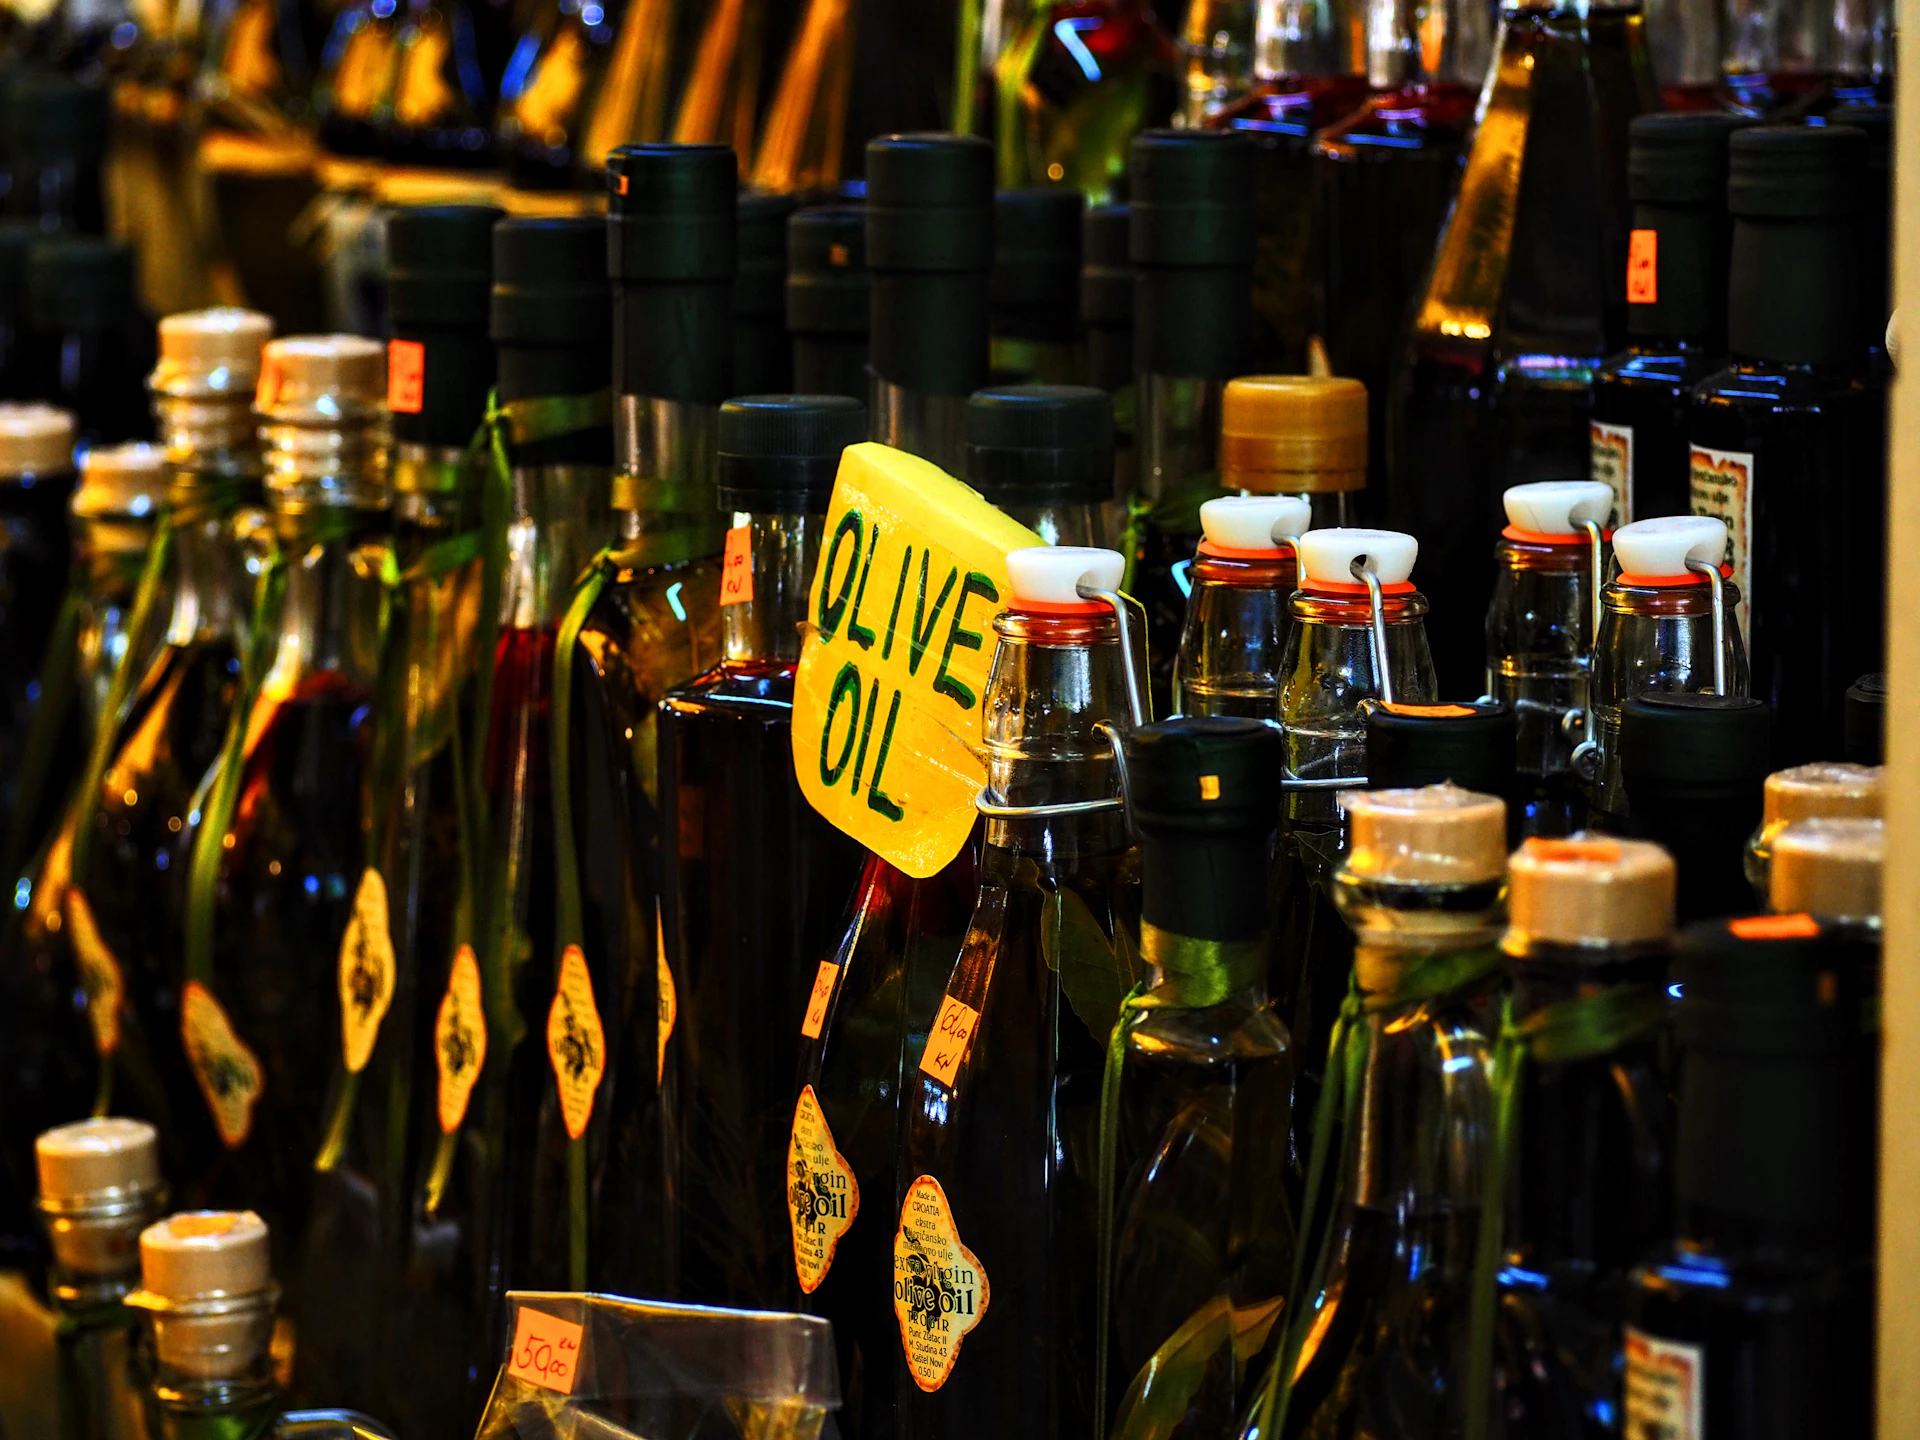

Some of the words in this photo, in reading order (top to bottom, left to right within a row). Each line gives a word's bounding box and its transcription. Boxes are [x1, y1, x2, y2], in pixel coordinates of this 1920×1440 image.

[818, 508, 999, 710] OLIVE
[819, 661, 905, 822] OIL
[916, 1189, 930, 1201] Made
[931, 1194, 937, 1202] in
[815, 1193, 847, 1218] oil
[912, 1201, 940, 1216] CROATIA
[915, 1217, 936, 1231] ekstra
[938, 1249, 953, 1261] ulje
[894, 1254, 923, 1277] extra
[924, 1260, 974, 1290] virgin
[895, 1277, 936, 1311] olive
[939, 1289, 974, 1315] oil
[907, 1310, 950, 1332] TROGIR
[939, 1347, 948, 1357] 43
[930, 1356, 944, 1369] Novi
